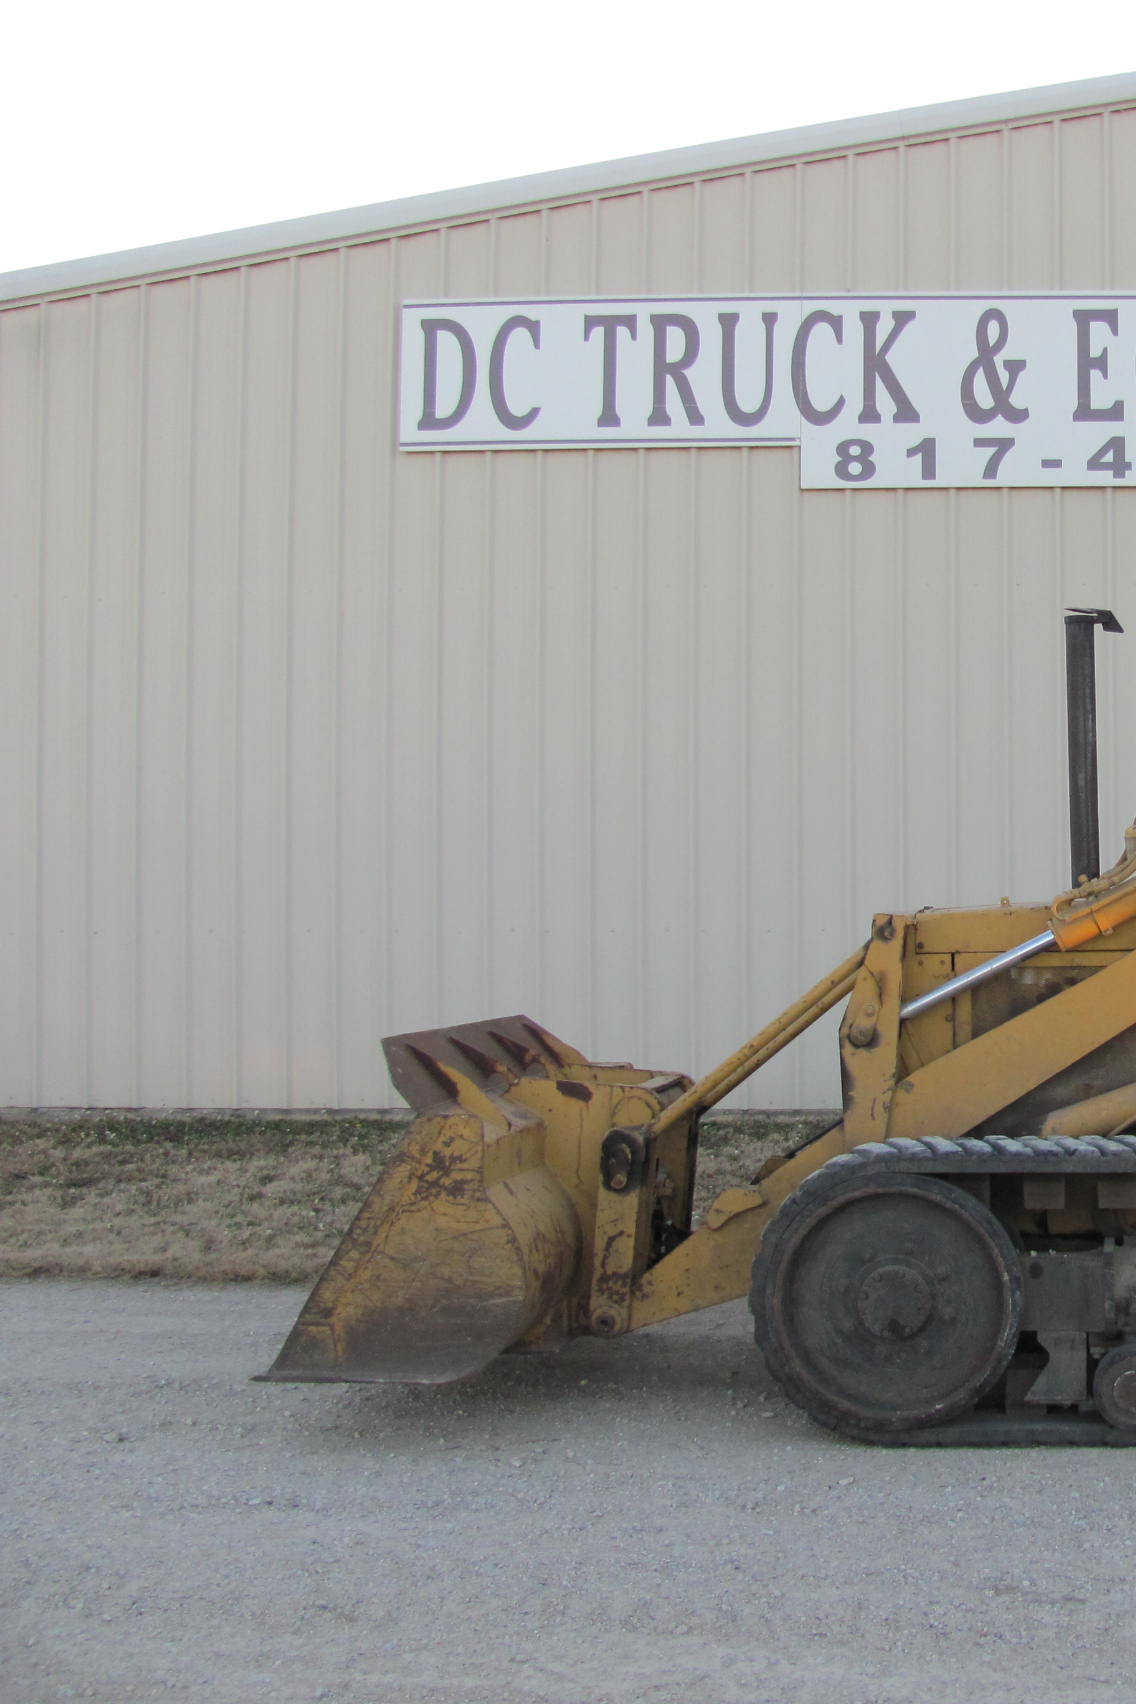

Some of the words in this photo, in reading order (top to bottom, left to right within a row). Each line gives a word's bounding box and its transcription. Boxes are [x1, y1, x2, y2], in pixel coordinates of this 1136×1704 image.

[416, 314, 542, 431] DC
[583, 309, 921, 428] TRUCK
[960, 307, 1030, 426] &
